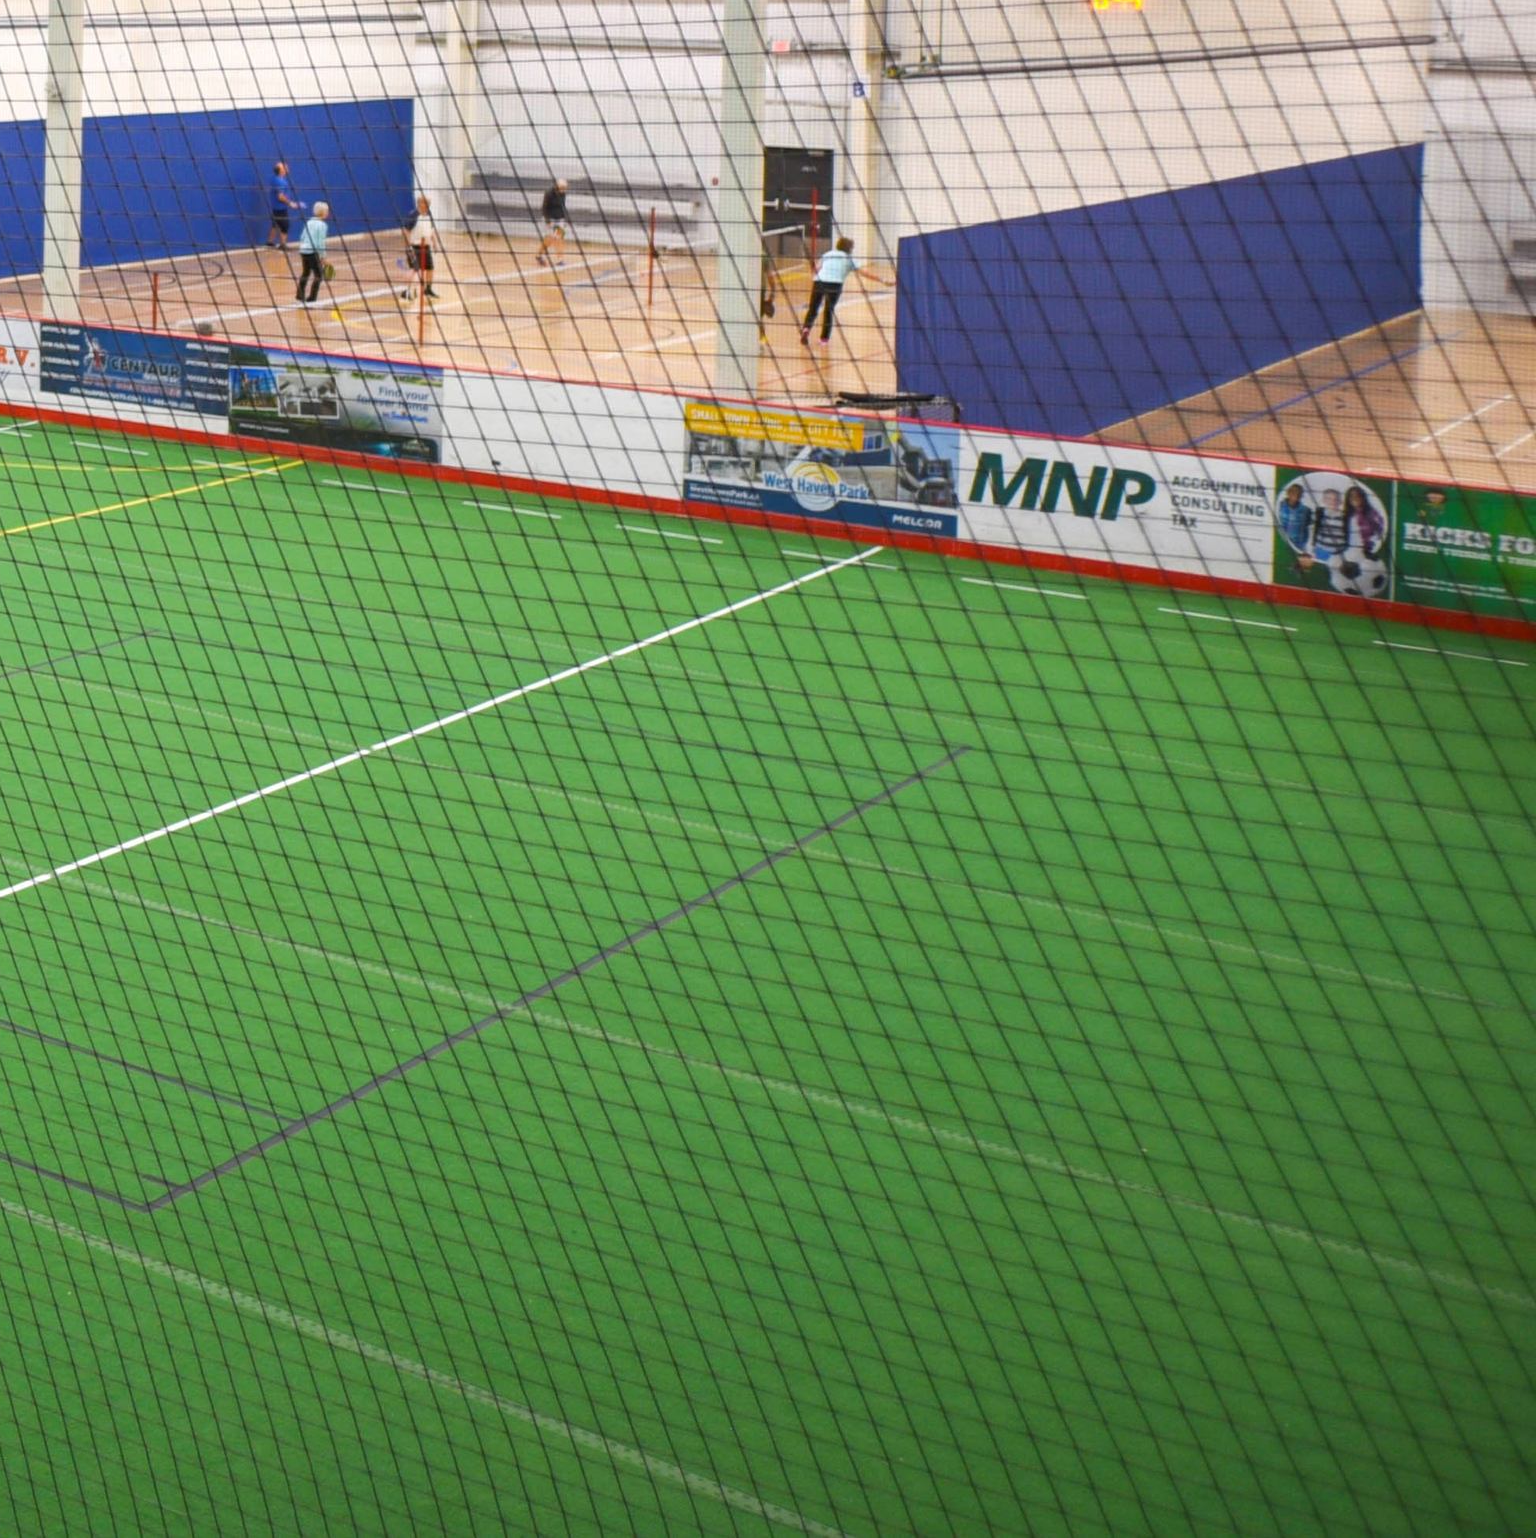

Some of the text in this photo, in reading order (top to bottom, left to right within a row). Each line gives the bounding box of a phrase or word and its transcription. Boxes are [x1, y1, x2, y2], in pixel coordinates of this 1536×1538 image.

[111, 356, 180, 376] CENTAUR
[379, 386, 428, 401] Find your
[693, 408, 718, 420] SMALL
[725, 412, 750, 424] TOWN
[763, 472, 868, 499] West Haven Park
[969, 452, 1156, 521] MNP
[1172, 476, 1266, 497] ACCOUNTING
[1172, 495, 1265, 517] CONSULTING
[892, 515, 942, 530] MELCOR
[1172, 514, 1197, 528] TAX
[1403, 522, 1492, 549] KICKS
